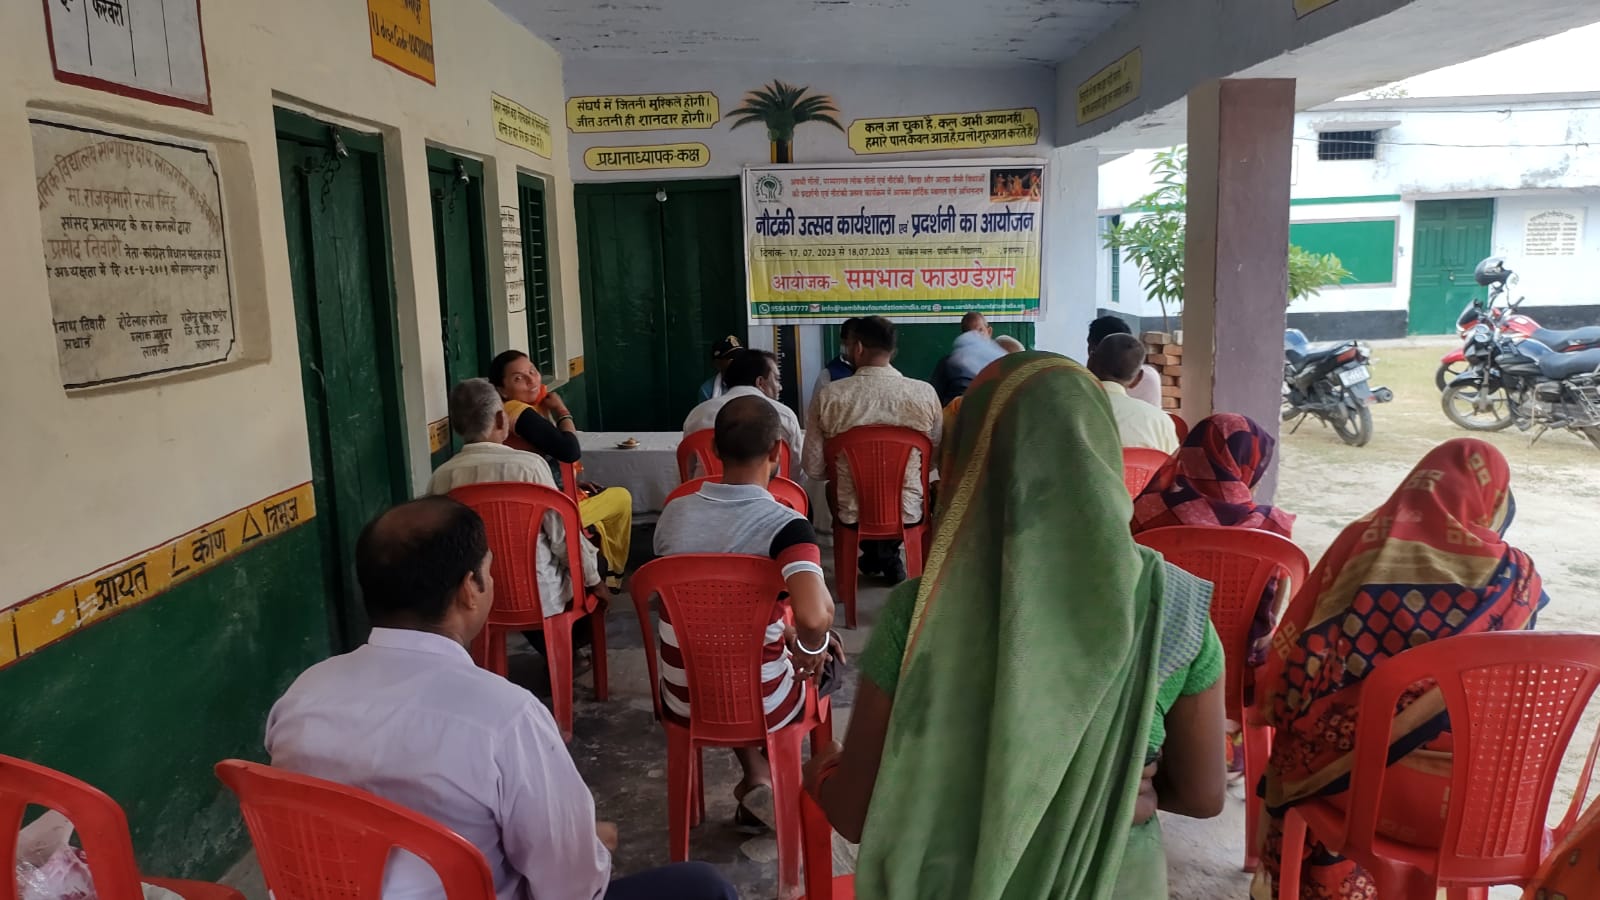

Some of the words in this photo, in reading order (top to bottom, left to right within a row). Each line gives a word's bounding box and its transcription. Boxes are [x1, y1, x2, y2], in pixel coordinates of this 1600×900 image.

[603, 97, 612, 111] में
[616, 97, 646, 110] जितनी
[596, 113, 623, 127] उतनी
[624, 113, 635, 127] ही
[639, 113, 678, 127] शानदार
[864, 122, 884, 134] कल
[885, 121, 899, 132] जा
[938, 118, 958, 130] कल
[960, 113, 983, 128] अभी
[889, 135, 908, 147] पास
[60, 213, 89, 232] सांसद
[128, 214, 138, 231] के
[755, 207, 795, 237] नौटंकी
[798, 215, 834, 236] उत्सव
[837, 205, 896, 236] कार्यशाला
[911, 204, 956, 238] प्रदर्शनी
[959, 213, 977, 233] का
[980, 205, 1035, 233] आयोजन
[46, 232, 82, 261] प्रमोद
[83, 233, 122, 259] तिवारी
[818, 248, 836, 257] 2023
[98, 261, 107, 276] में
[844, 268, 914, 290] समभाव
[920, 259, 1016, 289] फाउण्डेशन
[79, 314, 106, 332] तिवारी
[263, 496, 299, 534] त्रिभुज
[192, 528, 227, 564] कोण
[95, 562, 148, 611] आयत
